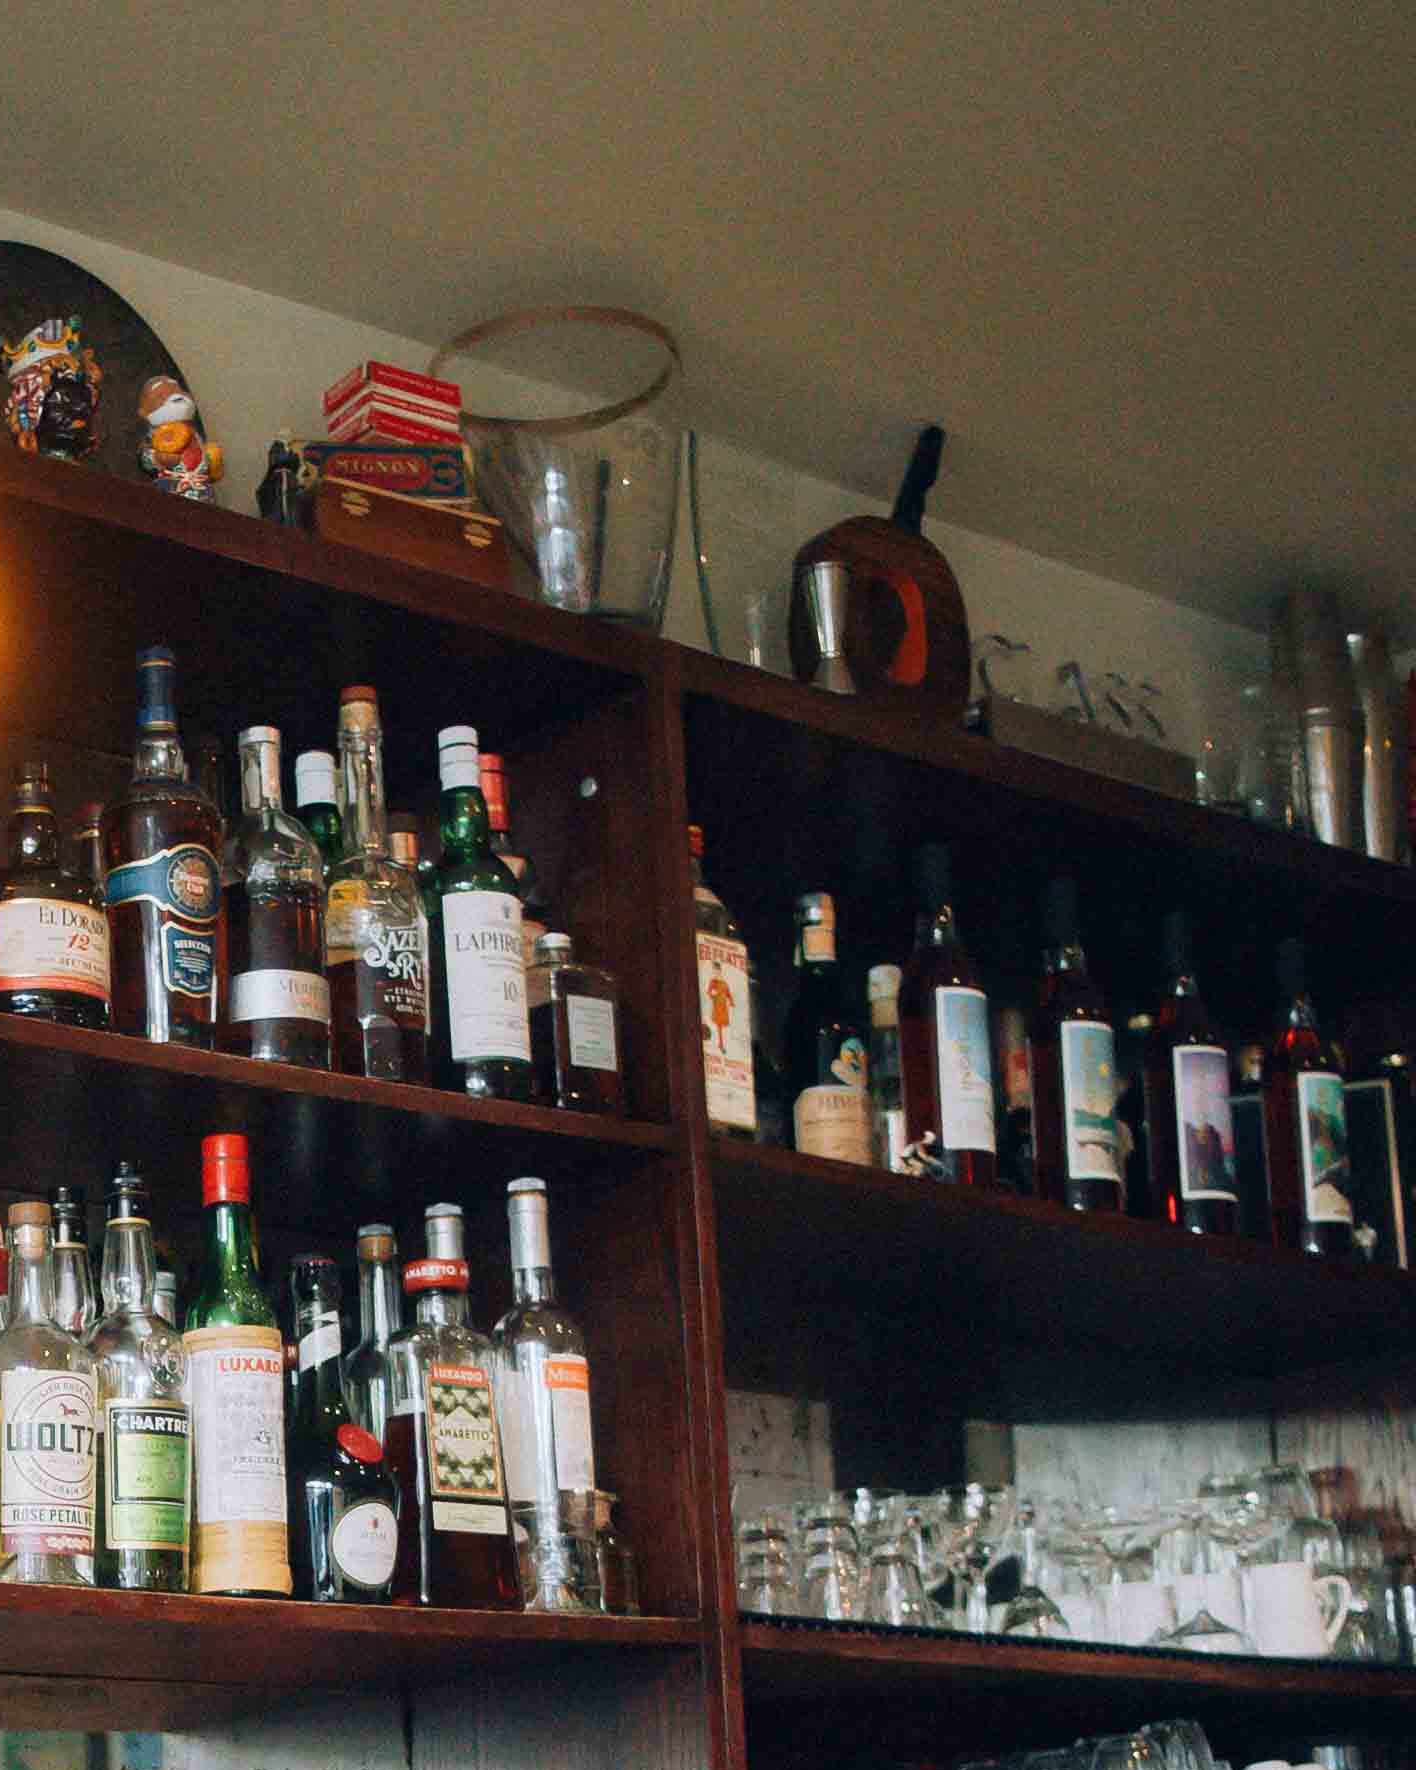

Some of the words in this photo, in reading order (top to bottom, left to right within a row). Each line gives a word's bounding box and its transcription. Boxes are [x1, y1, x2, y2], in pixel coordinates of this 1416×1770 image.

[68, 934, 90, 952] 12
[432, 1367, 483, 1383] LUXARDO
[6, 1423, 95, 1457] WOLTZ
[438, 1426, 491, 1442] AMARETTO
[12, 1507, 46, 1522] ROSE
[50, 1509, 83, 1525] PETAL
